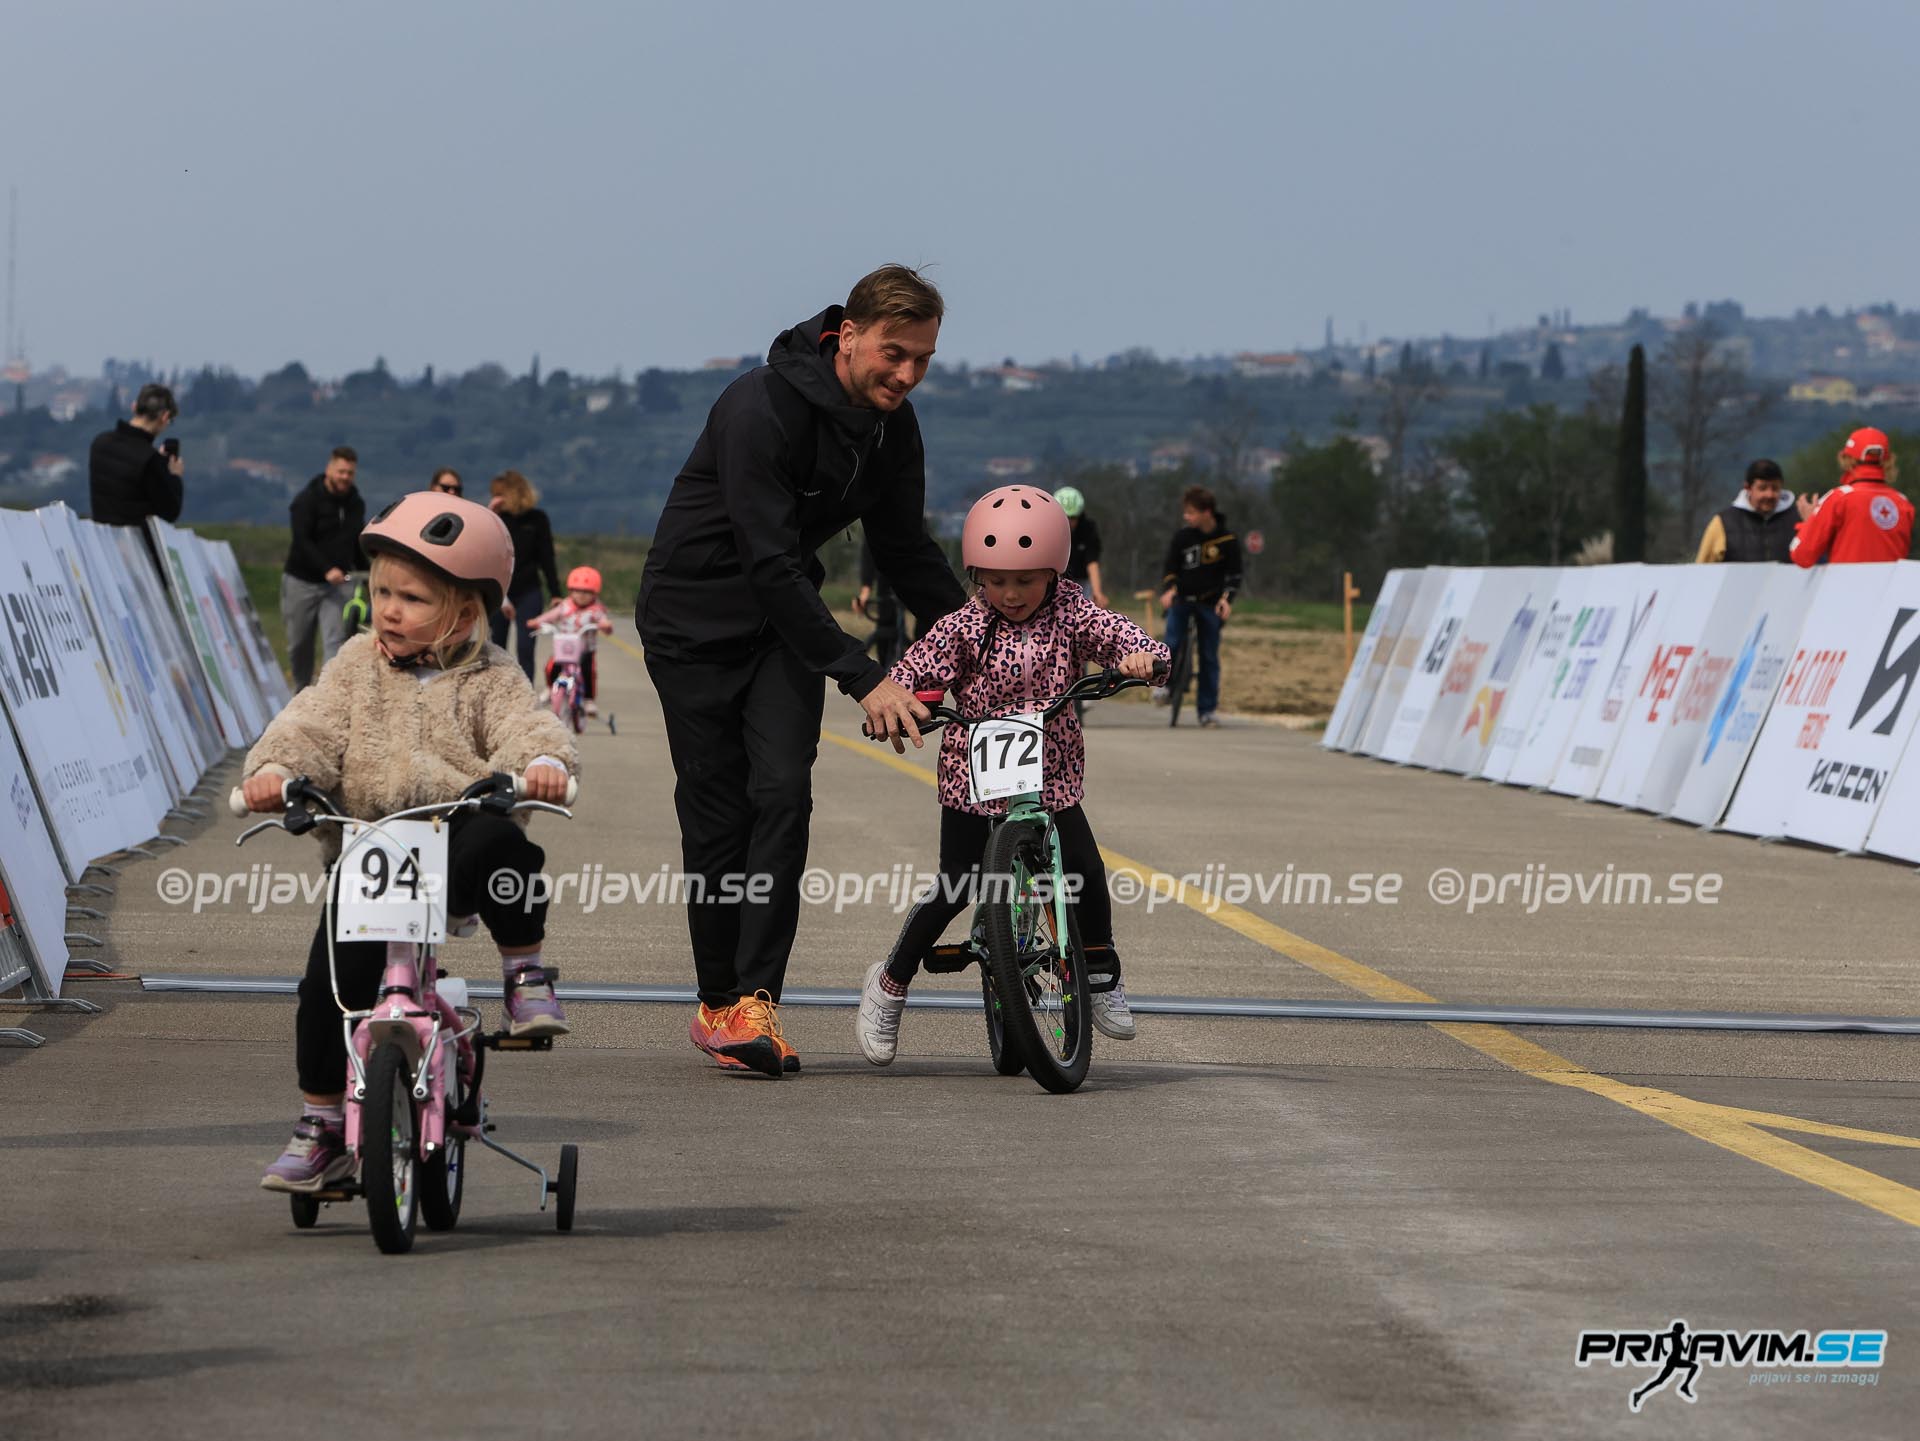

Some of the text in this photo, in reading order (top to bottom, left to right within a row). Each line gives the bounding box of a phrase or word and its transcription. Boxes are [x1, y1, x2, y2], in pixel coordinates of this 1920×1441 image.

[1639, 644, 1694, 722] MET
[973, 730, 1038, 772] 172
[361, 847, 420, 900] 94
